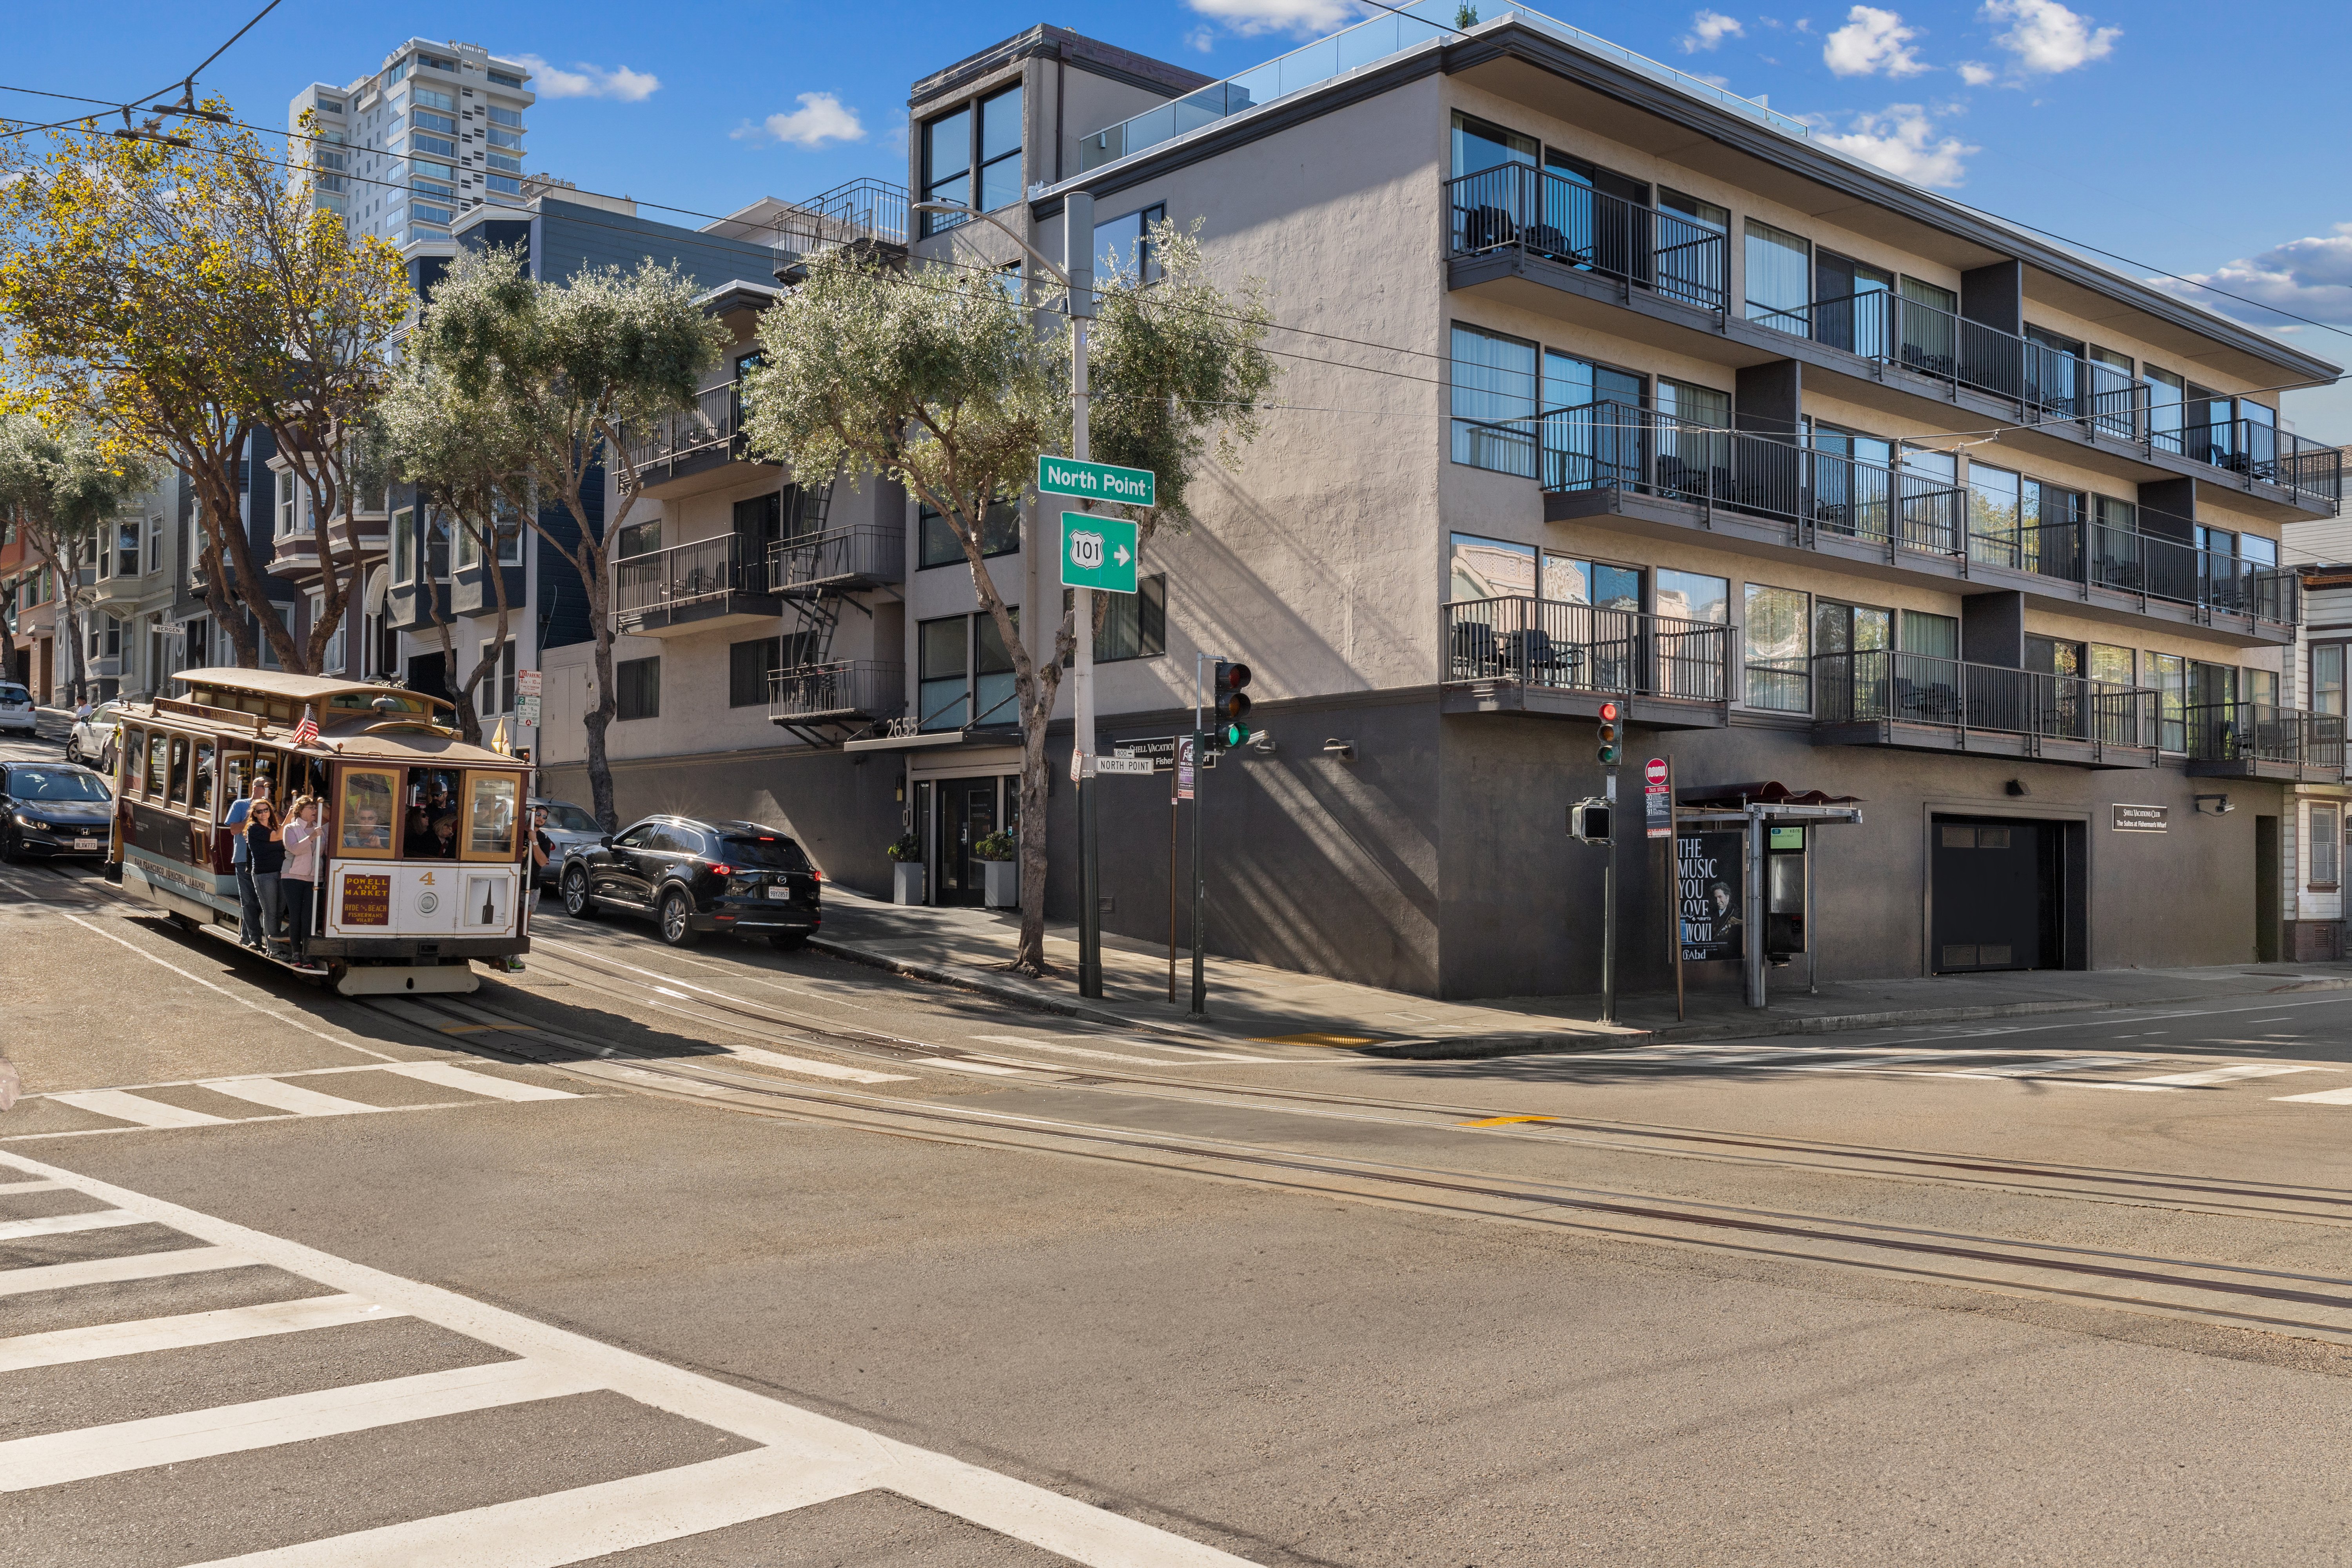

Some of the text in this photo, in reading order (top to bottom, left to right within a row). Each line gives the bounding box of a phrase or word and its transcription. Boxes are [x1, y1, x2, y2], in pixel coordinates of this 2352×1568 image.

[1048, 465, 1146, 497] North Point
[1076, 541, 1098, 560] 101
[160, 701, 193, 715] POWELL
[198, 708, 205, 717] &
[210, 710, 233, 722] HYDE
[887, 716, 918, 739] 2655
[1101, 760, 1149, 771] NORTH POINT
[127, 817, 131, 828] 4
[1677, 838, 1702, 858] THE
[134, 857, 142, 868] SAN
[143, 860, 164, 875] FRANCISCO
[1678, 858, 1717, 878] MUSIC
[419, 871, 435, 886] 4
[1679, 879, 1703, 899] YOU
